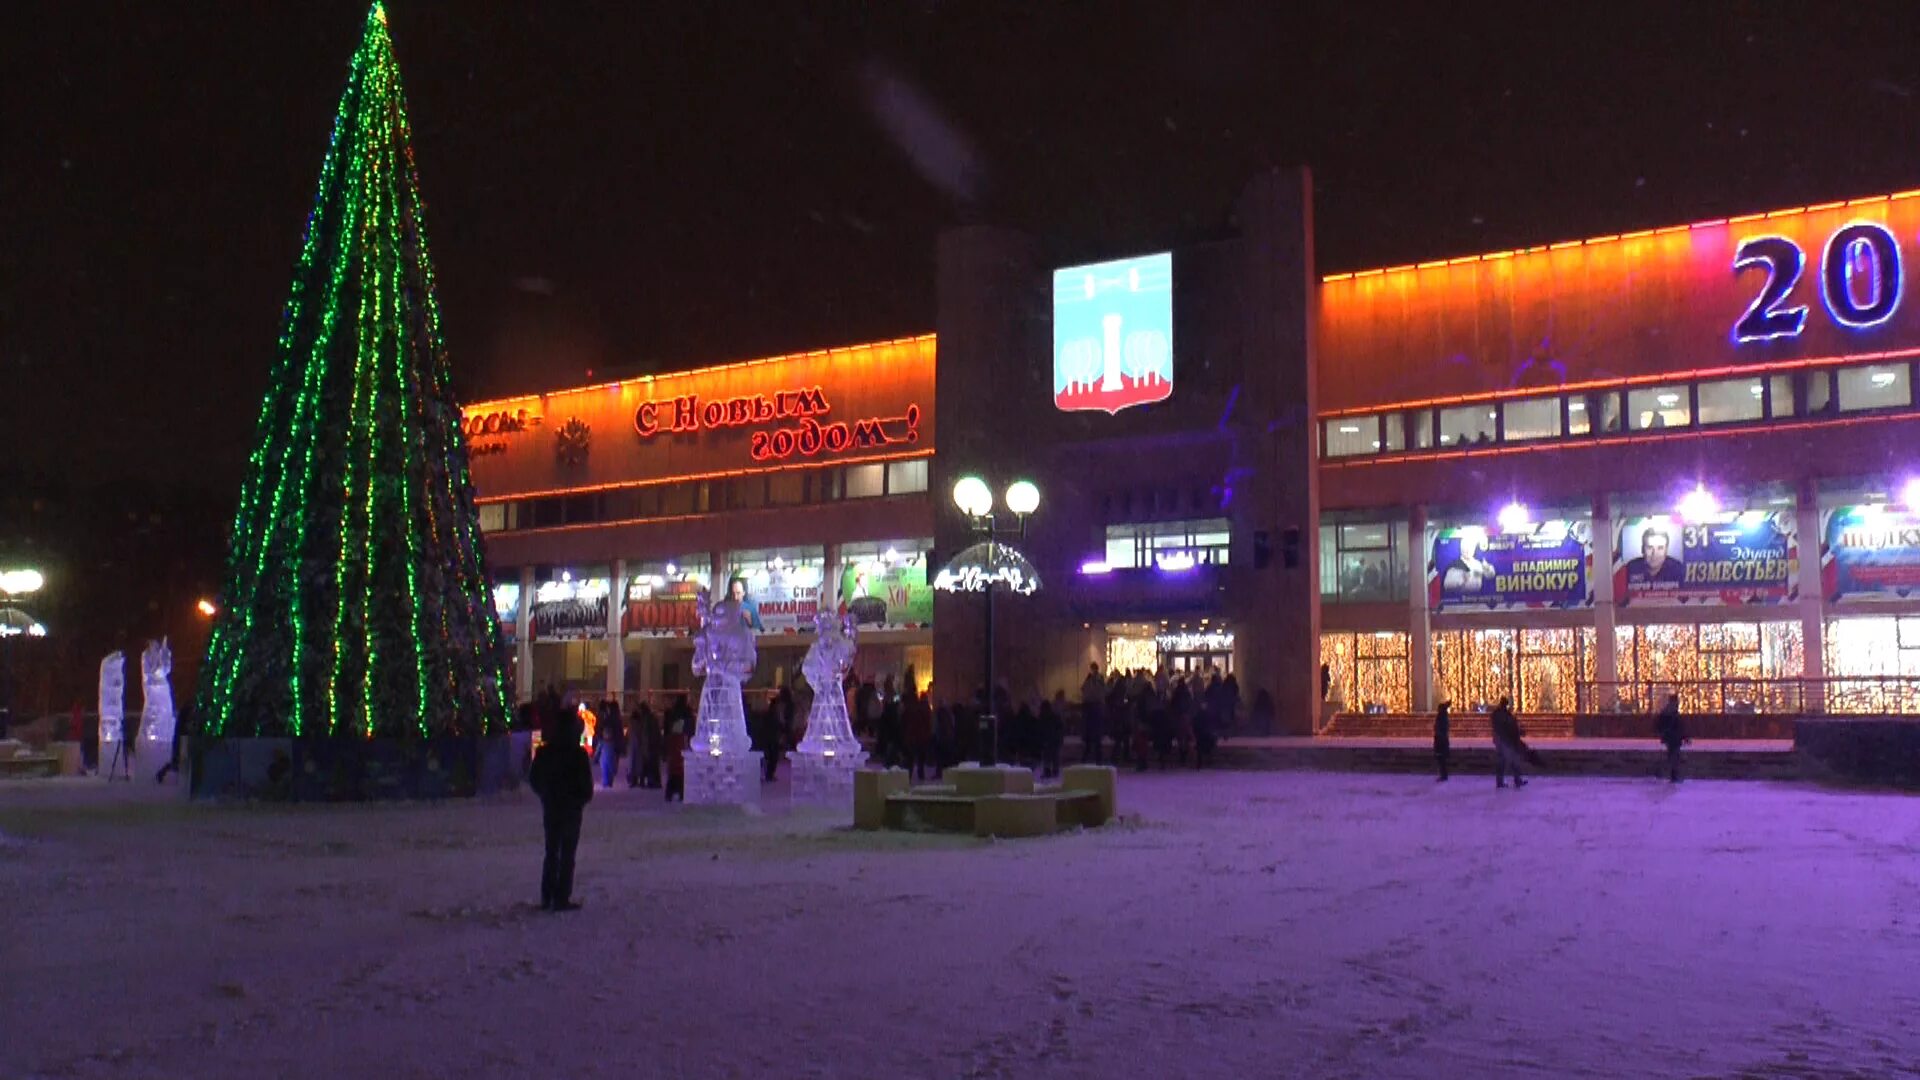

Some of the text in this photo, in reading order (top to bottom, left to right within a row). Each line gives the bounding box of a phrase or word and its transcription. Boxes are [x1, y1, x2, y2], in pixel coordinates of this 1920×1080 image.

[1734, 221, 1905, 343] 20
[634, 386, 830, 436] С Новым
[1684, 526, 1710, 548] 31
[1730, 547, 1785, 562] Эдуард
[1512, 559, 1579, 574] ВЛАДИМИР
[1684, 560, 1788, 583] ИЗМЕСТЬЕВ
[1494, 573, 1579, 592] ВИНОКУР
